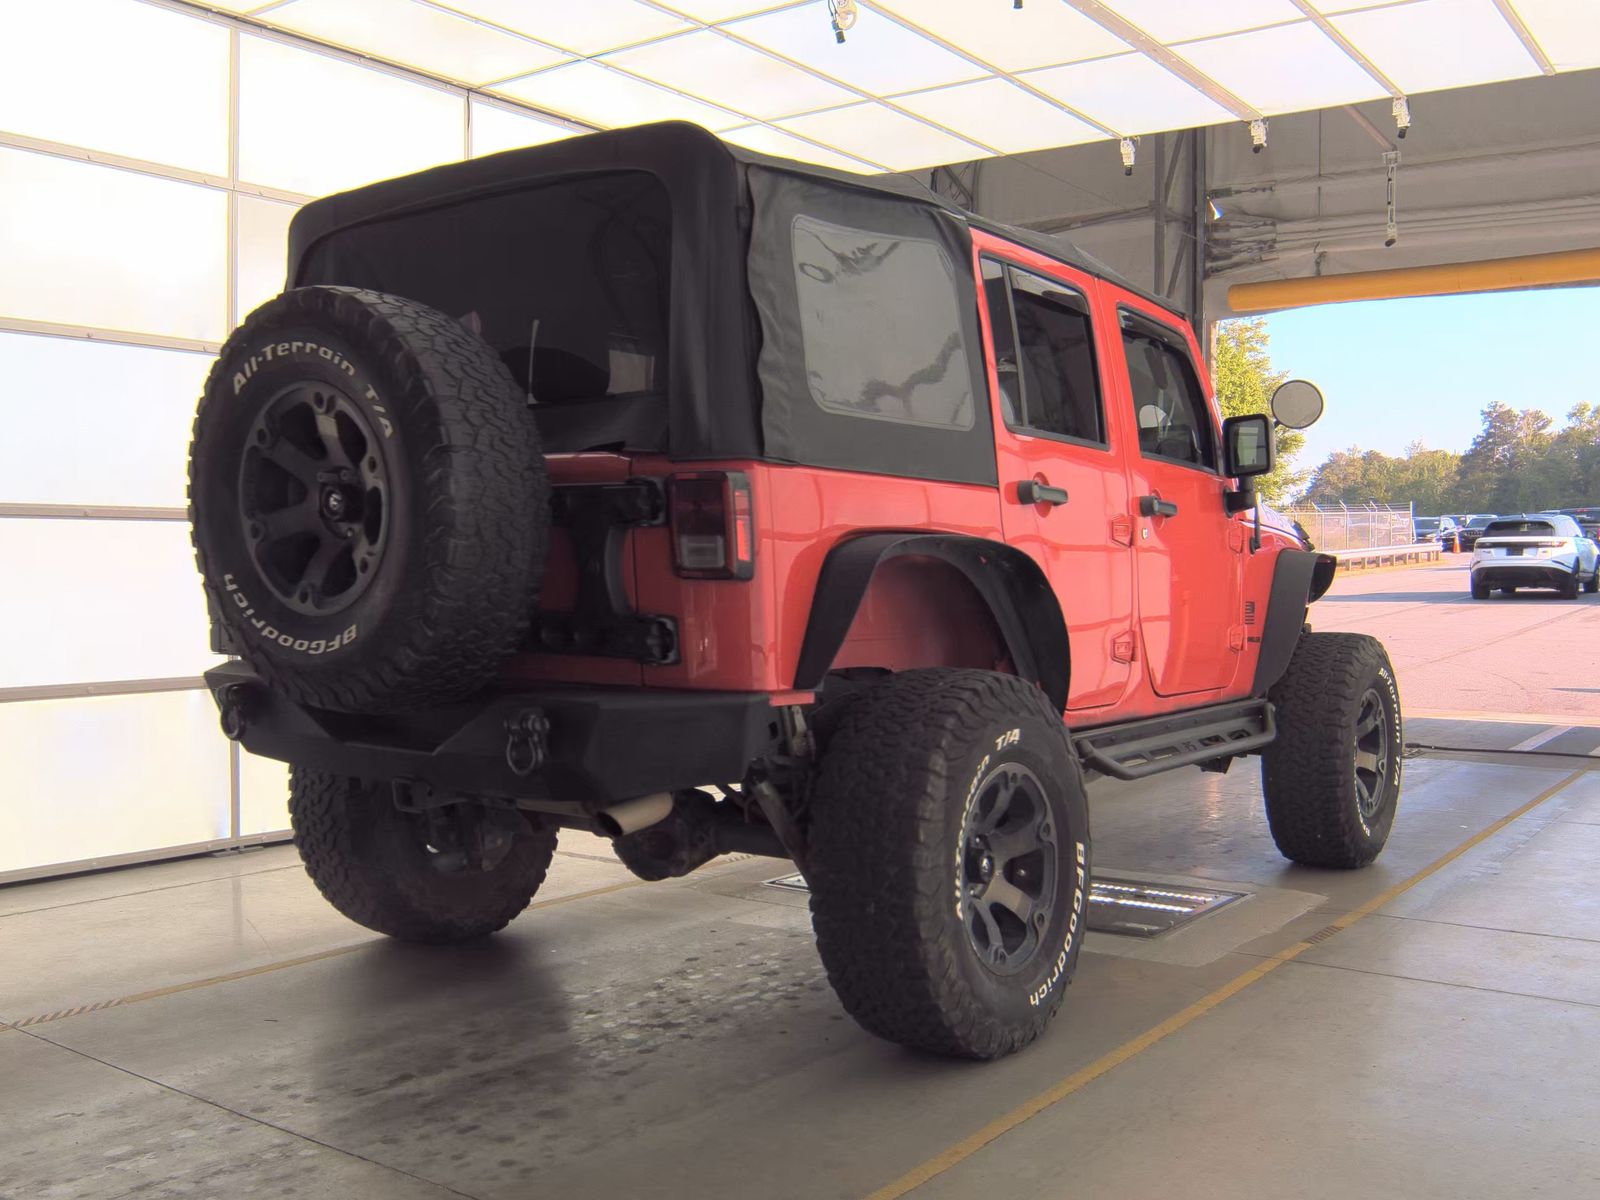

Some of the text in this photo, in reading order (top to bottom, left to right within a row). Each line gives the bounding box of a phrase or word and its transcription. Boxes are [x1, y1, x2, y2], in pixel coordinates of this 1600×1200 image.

[233, 340, 396, 439] All-Terrain T/A
[222, 573, 358, 655] BFGoodrich
[995, 727, 1021, 751] T/A
[1378, 667, 1401, 744] All-Terrain
[1029, 840, 1086, 1008] BFGoodrich
